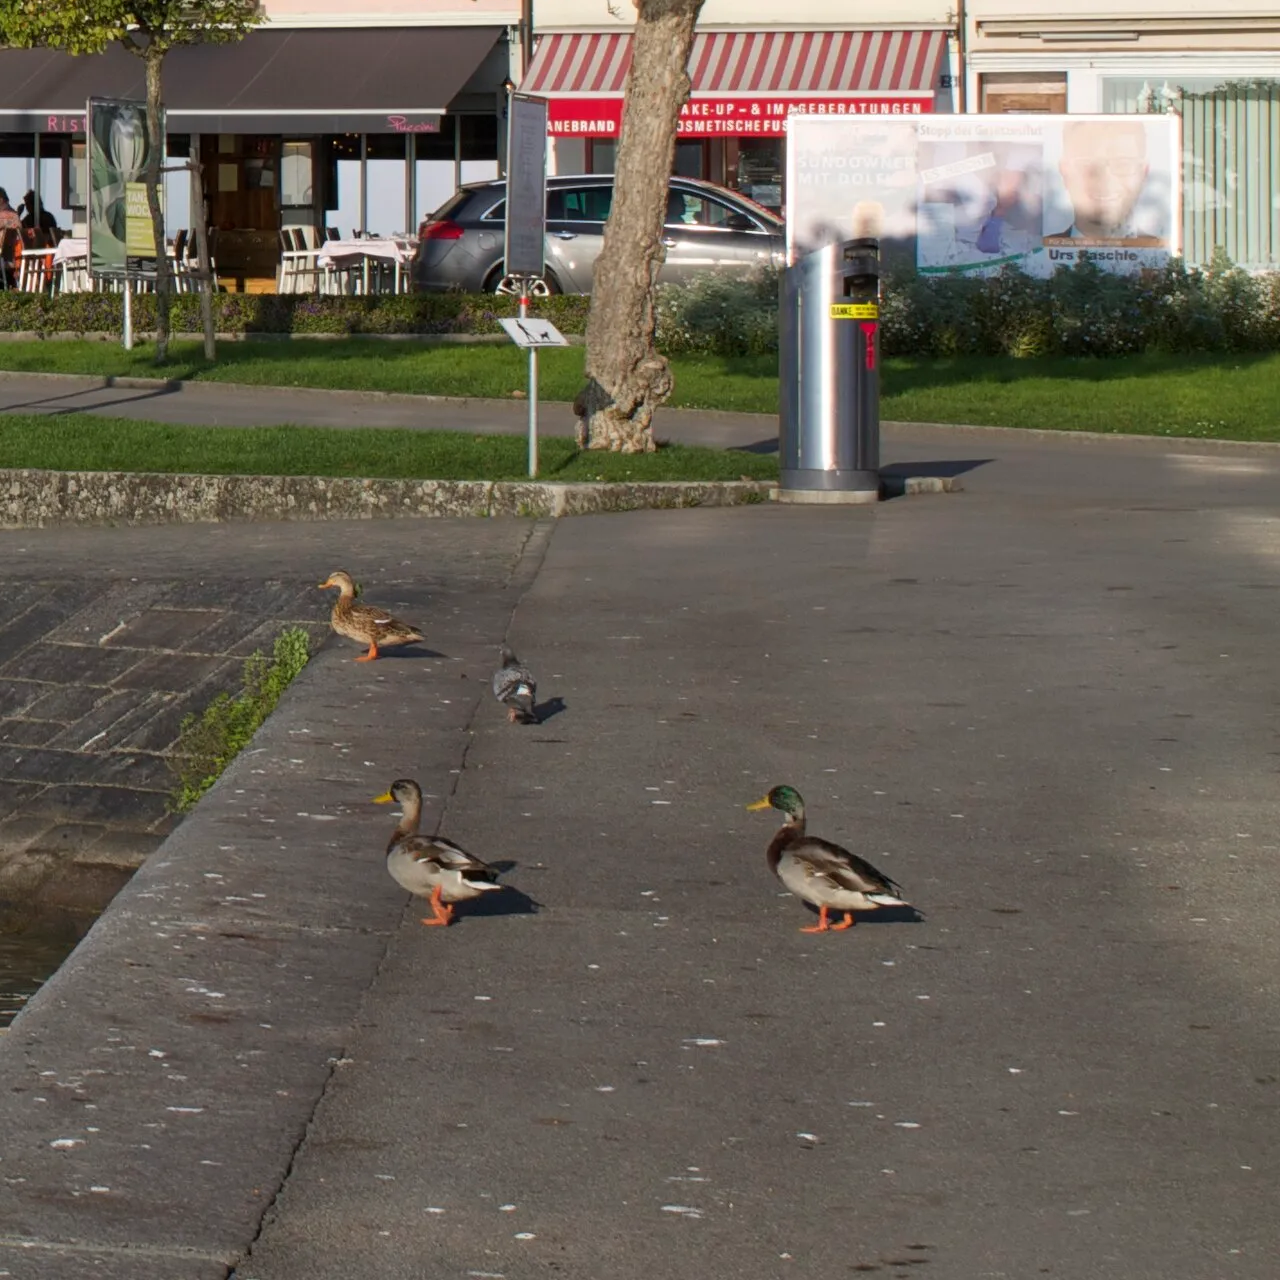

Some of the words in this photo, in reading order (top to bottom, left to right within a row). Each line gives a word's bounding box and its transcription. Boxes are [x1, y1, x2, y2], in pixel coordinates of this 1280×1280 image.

[767, 103, 922, 115] IMAGEBERATUNGEN
[920, 124, 951, 138] Stopp
[954, 123, 971, 136] der
[798, 173, 831, 186] MIT
[1049, 249, 1074, 261] Urs
